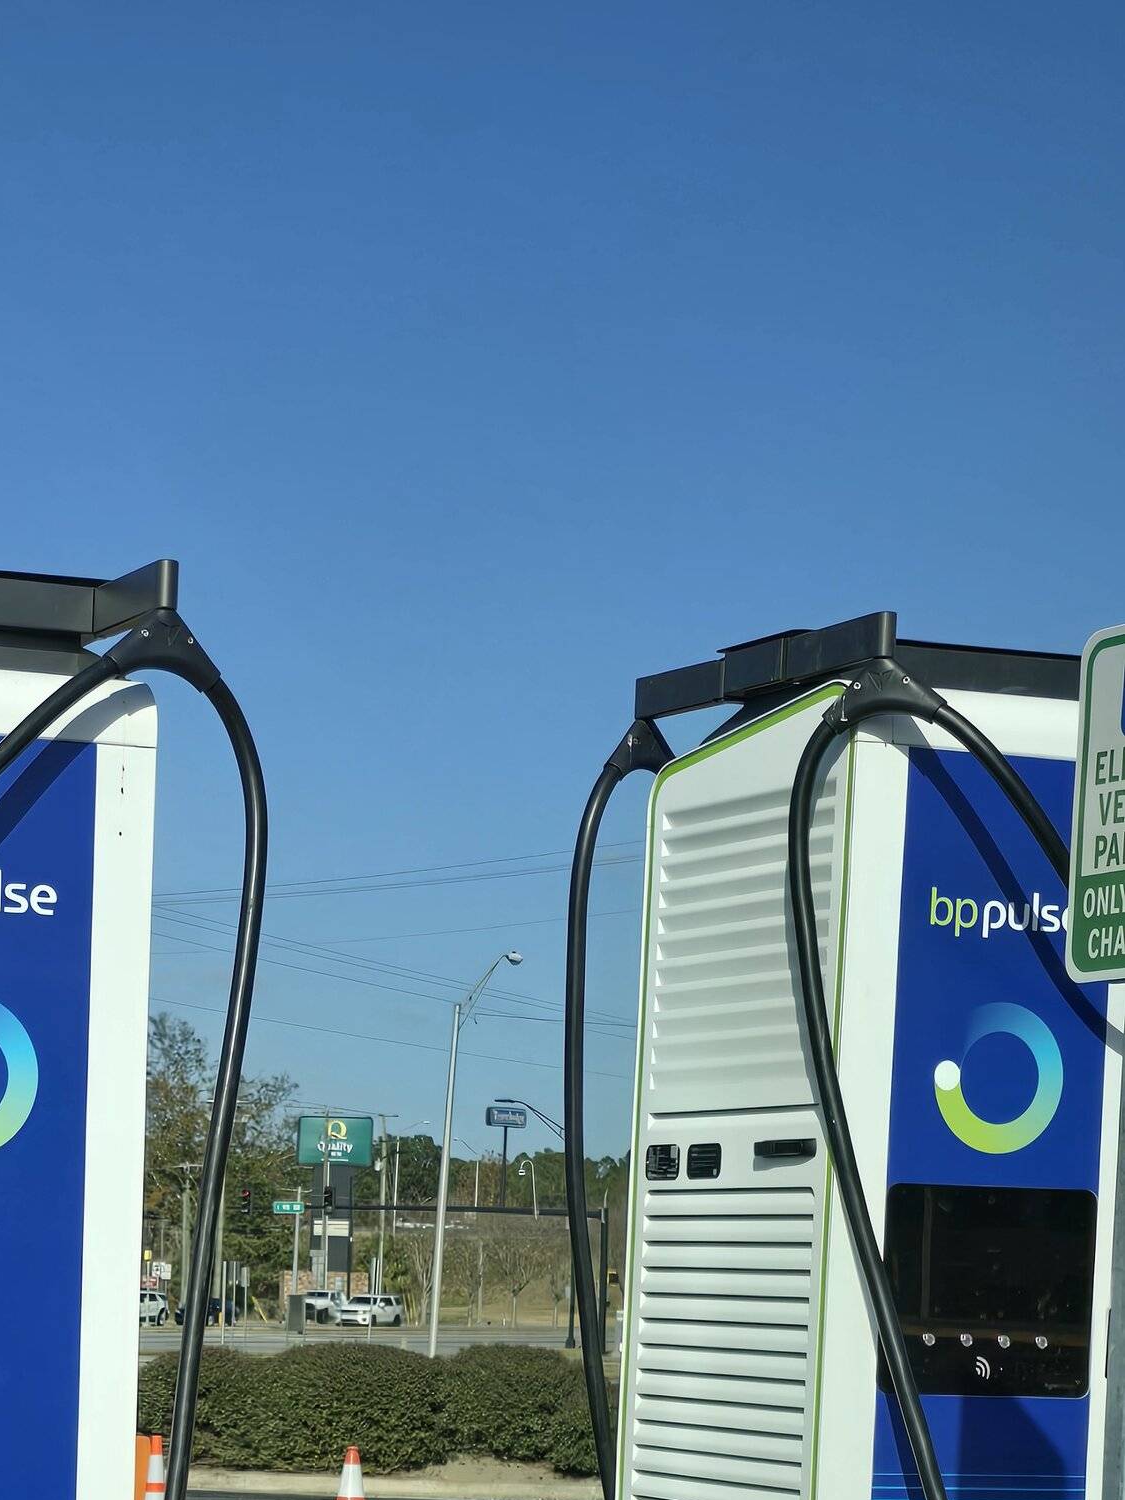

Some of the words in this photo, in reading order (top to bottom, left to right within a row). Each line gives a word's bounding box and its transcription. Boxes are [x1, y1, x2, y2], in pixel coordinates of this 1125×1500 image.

[1095, 748, 1125, 785] EL
[1094, 832, 1125, 869] PA
[930, 886, 979, 937] bp
